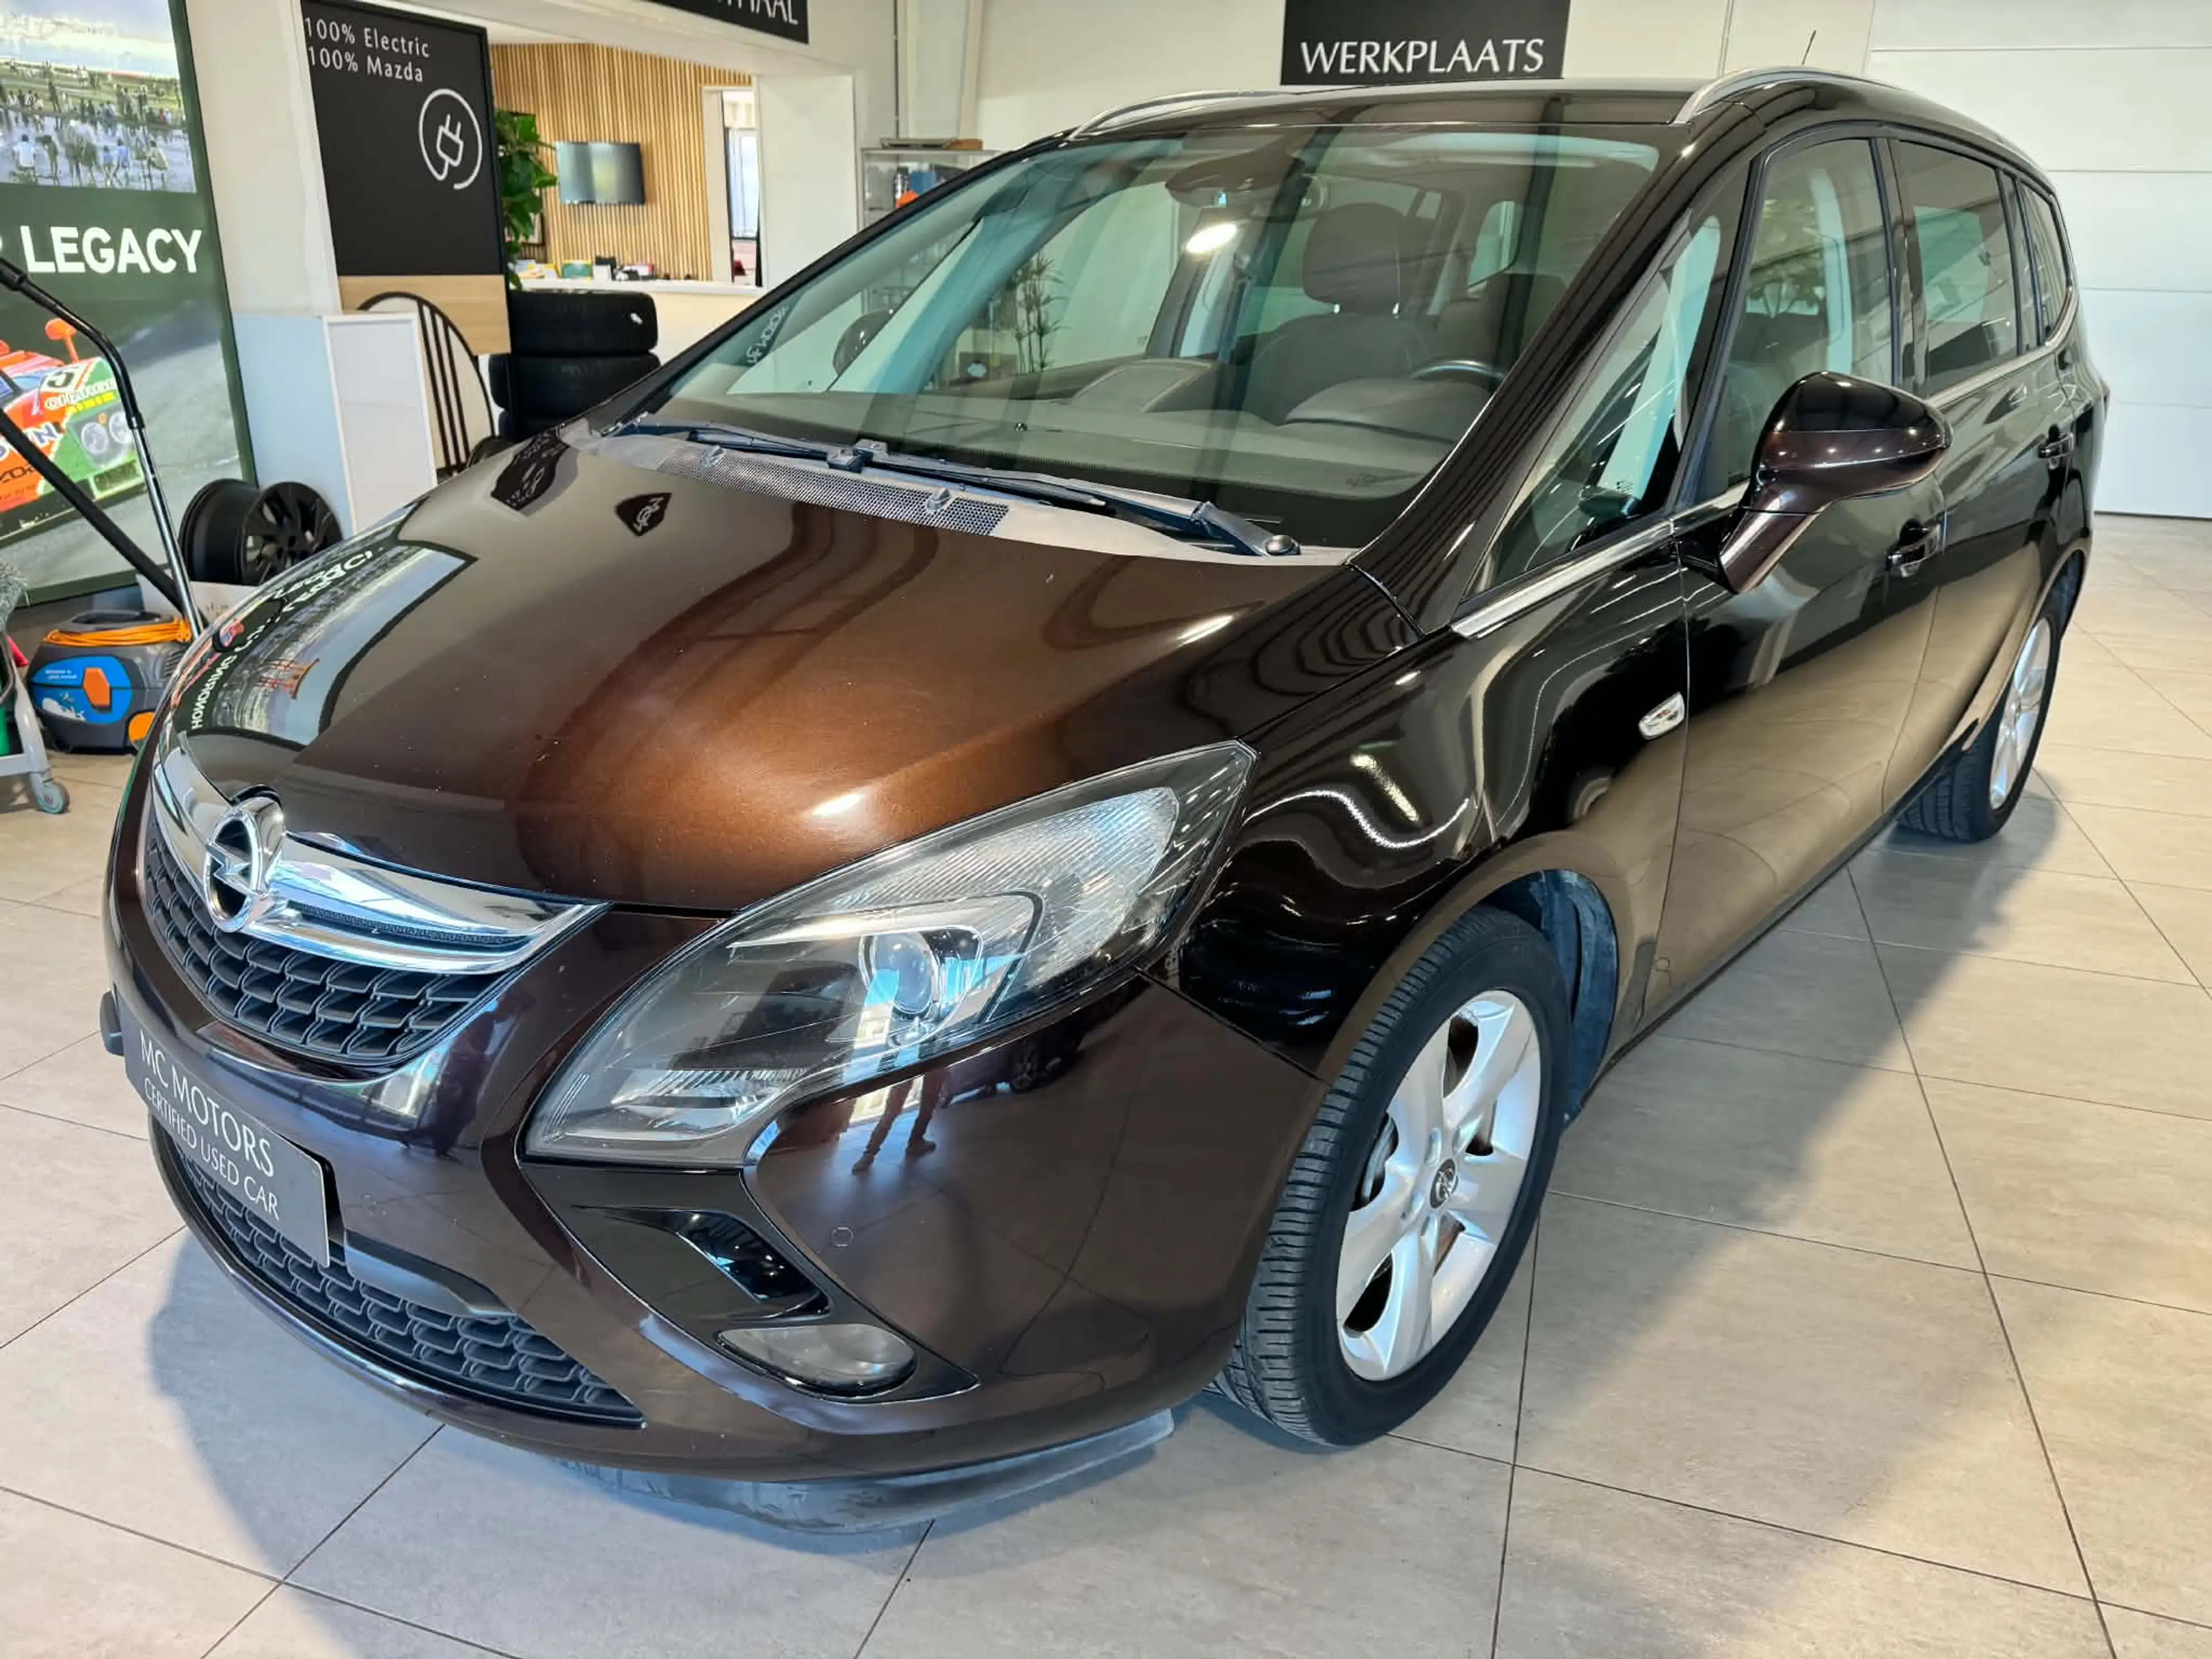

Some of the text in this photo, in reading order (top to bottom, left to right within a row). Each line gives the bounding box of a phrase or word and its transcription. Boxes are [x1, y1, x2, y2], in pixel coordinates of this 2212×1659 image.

[304, 17, 430, 58] 100% Electric
[1300, 39, 1544, 74] WERKPLAATS
[308, 46, 423, 82] 100% Mazda
[20, 225, 202, 274] LEGACY
[140, 1028, 274, 1178] MC MOTORS
[144, 1078, 280, 1221] CERTIFIED USED CAR
